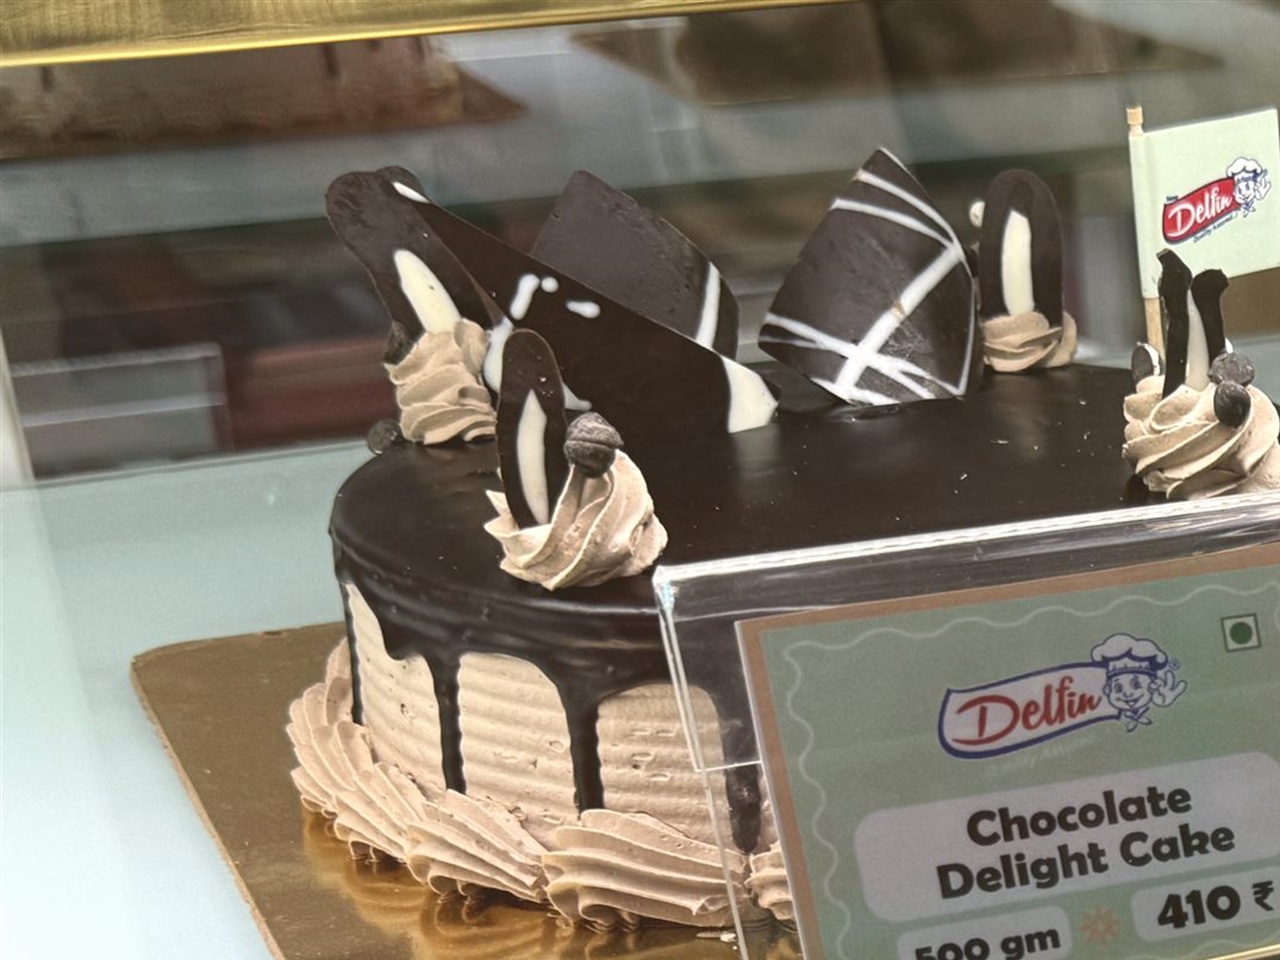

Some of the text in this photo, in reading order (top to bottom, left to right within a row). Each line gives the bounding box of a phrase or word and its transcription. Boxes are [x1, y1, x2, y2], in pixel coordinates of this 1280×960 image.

[1168, 187, 1233, 237] Delfin
[951, 676, 1102, 746] Delfin
[966, 786, 1192, 847] Chocolate
[936, 825, 1236, 900] Delight Cake
[1156, 885, 1242, 930] 410
